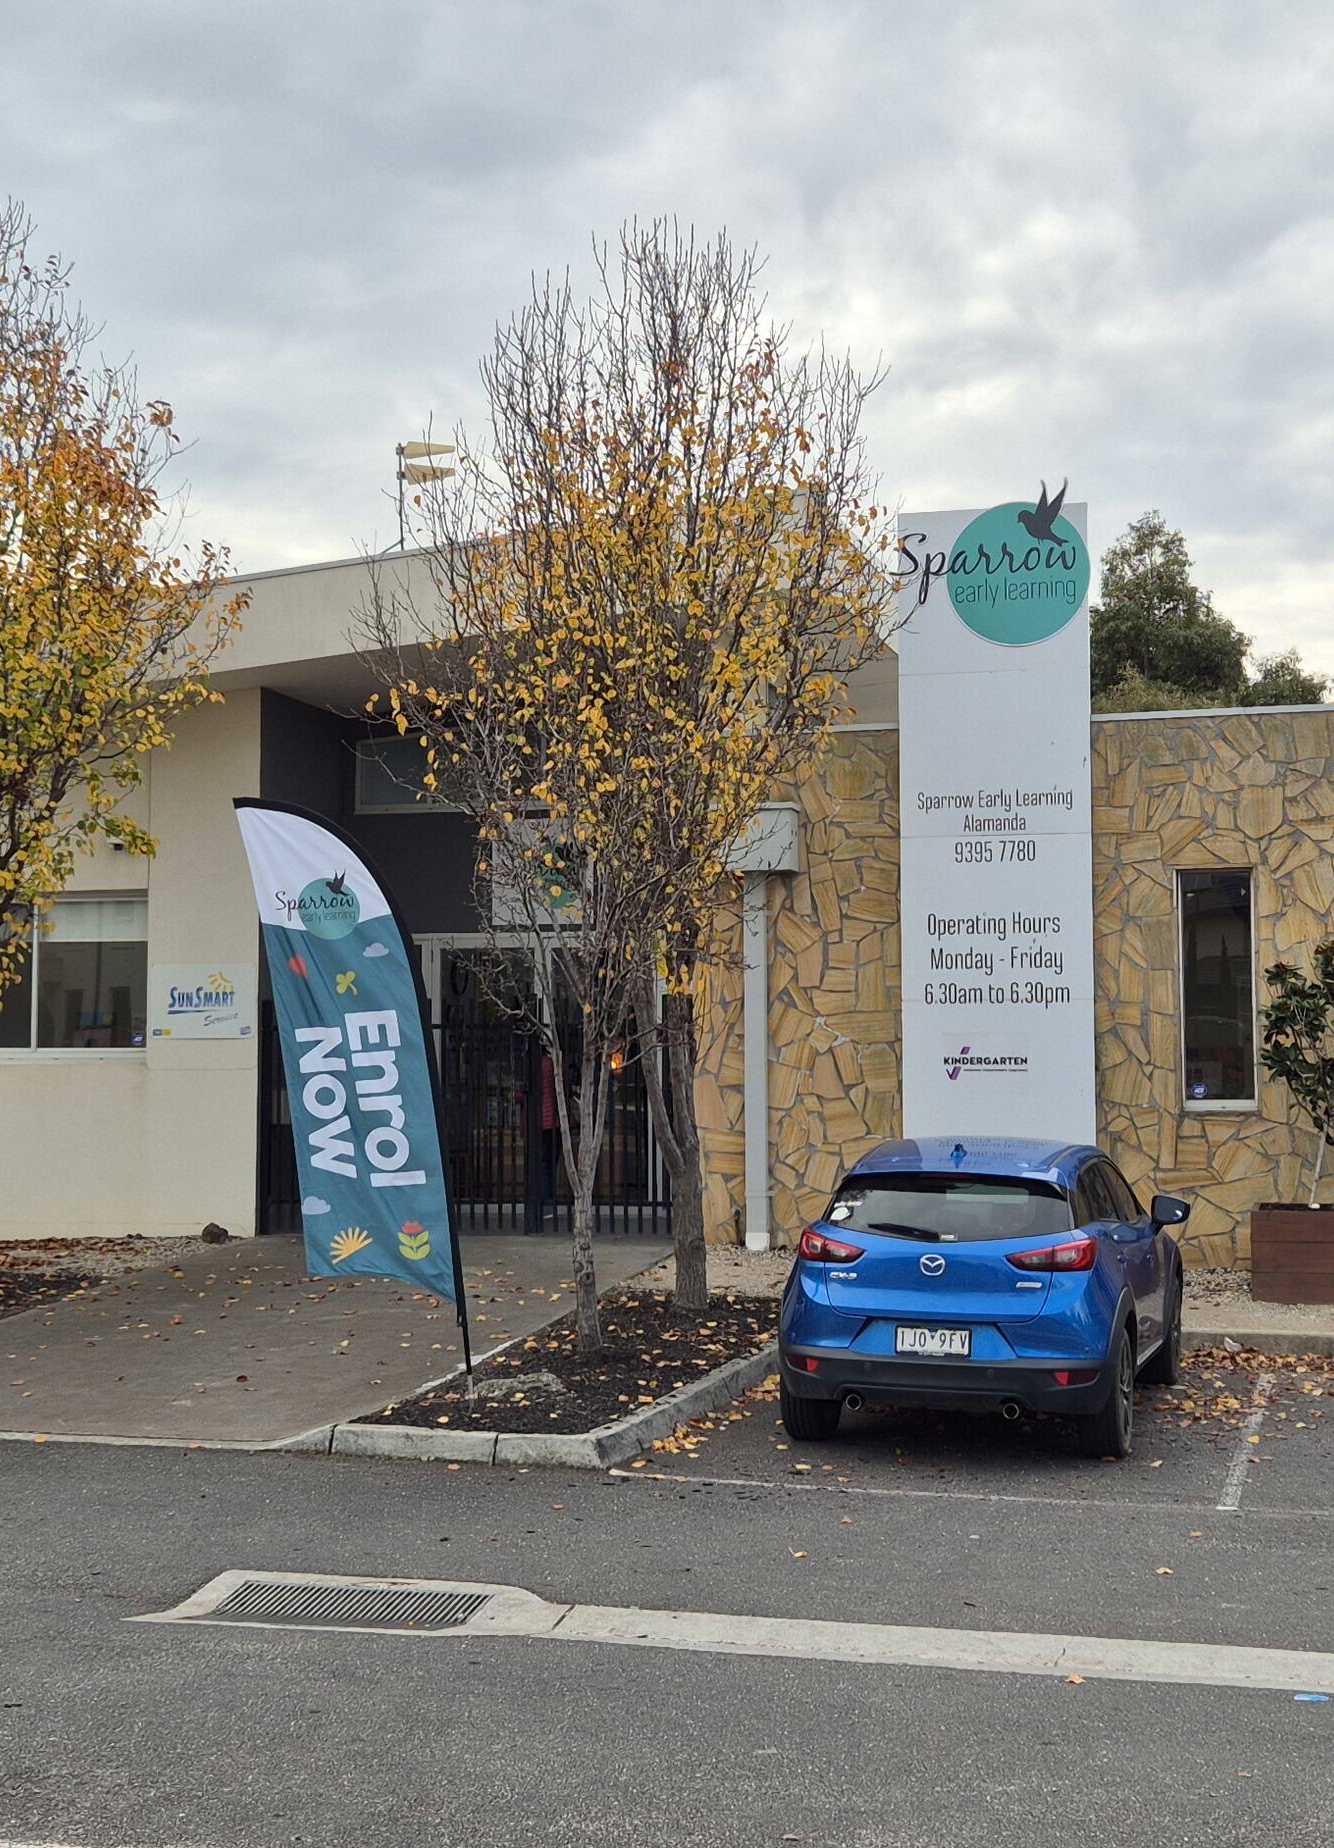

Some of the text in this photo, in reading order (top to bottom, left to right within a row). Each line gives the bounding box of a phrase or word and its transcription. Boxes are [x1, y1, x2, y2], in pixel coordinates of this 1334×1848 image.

[889, 533, 1076, 604] Sparrow
[955, 575, 1076, 608] early learning
[917, 787, 1073, 816] Sparrow Early Learning
[963, 813, 1026, 832] Alamanda
[954, 840, 1036, 863] 9395 7780
[275, 891, 354, 921] Sparrow
[927, 911, 1061, 940] Operating Hours
[930, 946, 994, 975] Monday
[1010, 944, 1063, 974] Friday
[924, 982, 1070, 1009] 6.30am to 6.30pm
[943, 1056, 1028, 1066] KINDERGARTEN
[344, 1008, 427, 1188] Enrol
[939, 1332, 967, 1349] 9FV
